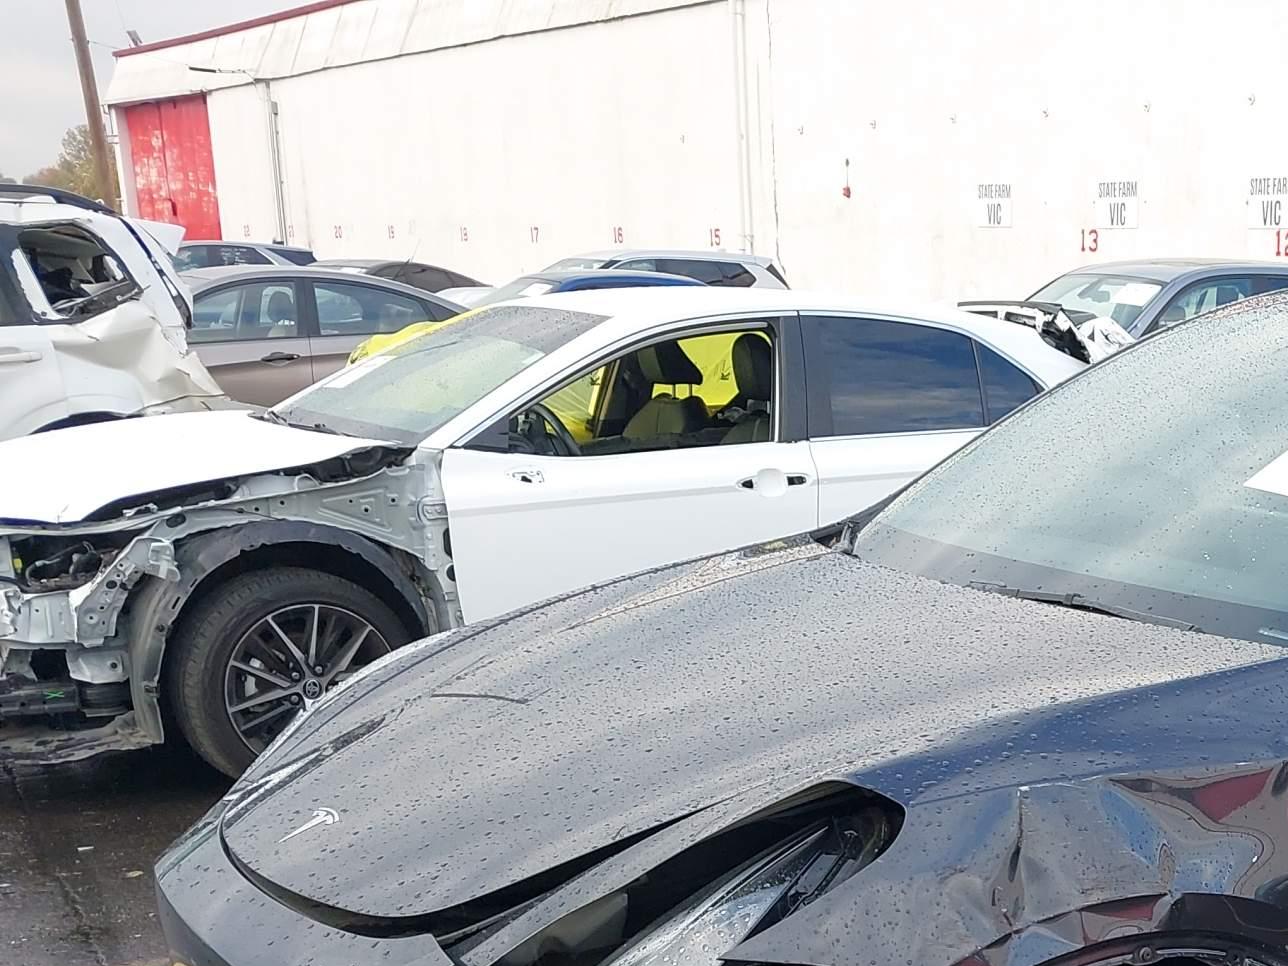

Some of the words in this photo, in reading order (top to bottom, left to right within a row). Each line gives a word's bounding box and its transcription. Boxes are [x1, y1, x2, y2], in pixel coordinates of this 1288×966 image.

[978, 184, 994, 199] STATE
[995, 184, 1011, 199] FARM
[1098, 181, 1117, 198] STATE
[1118, 180, 1138, 198] FARM
[1250, 177, 1270, 196] STATE
[987, 203, 1002, 225] VIC
[1109, 202, 1126, 226] VIC
[1261, 199, 1281, 226] VIC
[530, 225, 539, 244] 17
[613, 226, 624, 244] 16
[709, 227, 721, 247] 15
[1081, 229, 1099, 252] 13
